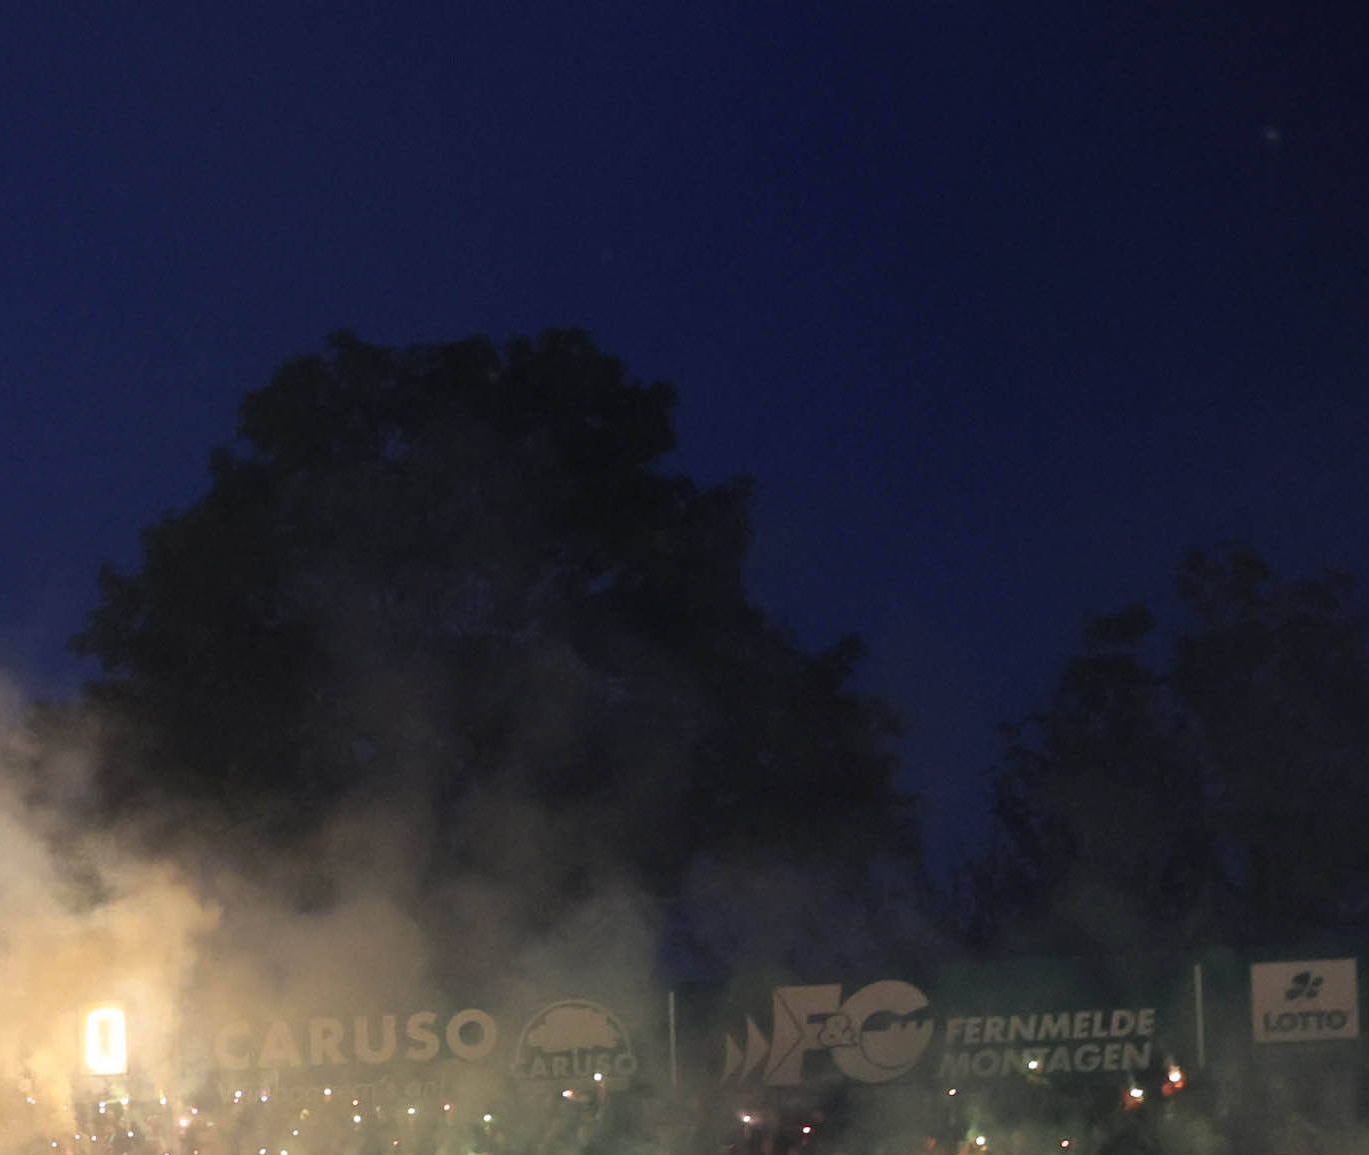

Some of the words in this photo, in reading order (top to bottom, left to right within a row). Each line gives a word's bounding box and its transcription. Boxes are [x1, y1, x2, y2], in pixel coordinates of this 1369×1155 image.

[214, 1008, 497, 1069] CARUSO
[945, 1007, 1157, 1048] FERNMELDE
[1264, 1009, 1347, 1032] LOTTO
[938, 1041, 1152, 1077] MONTAGEN
